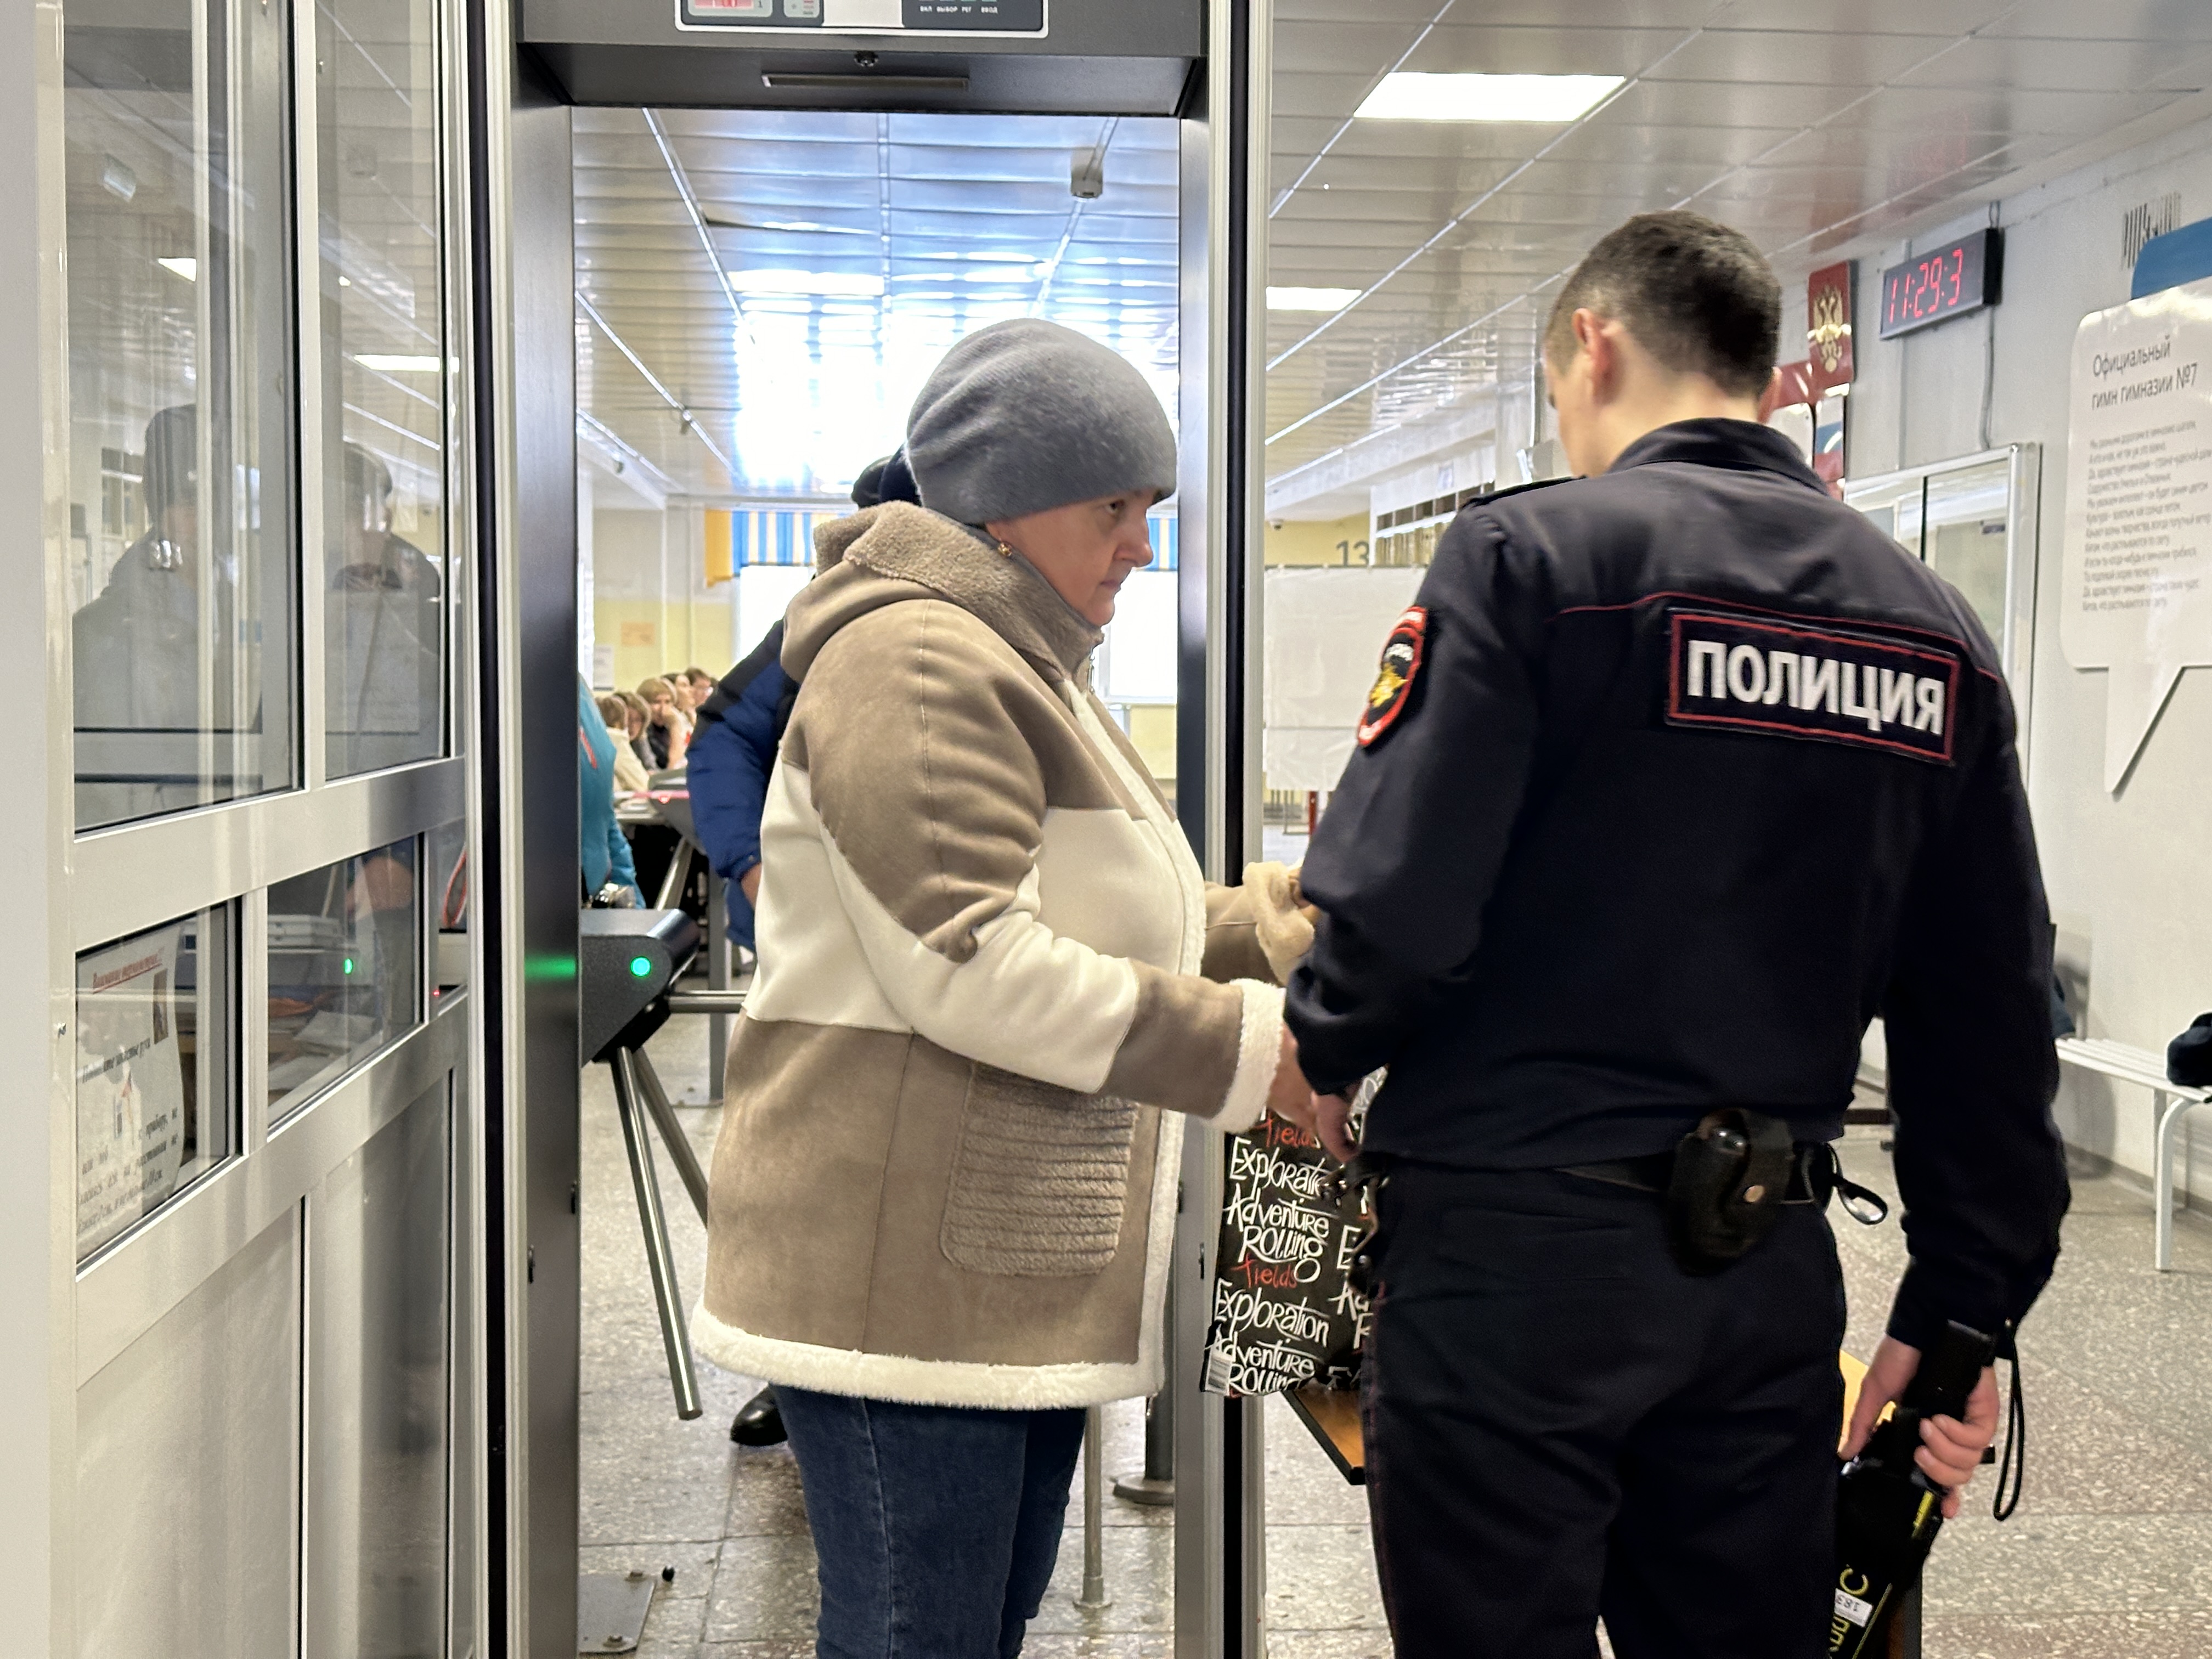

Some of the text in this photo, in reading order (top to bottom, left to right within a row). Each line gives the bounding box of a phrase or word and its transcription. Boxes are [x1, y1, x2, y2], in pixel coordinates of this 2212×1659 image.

[2092, 334, 2171, 381] Официальный
[2091, 362, 2198, 410] гимн гимназии №7
[1686, 639, 1946, 736] ПОЛИЦИЯ
